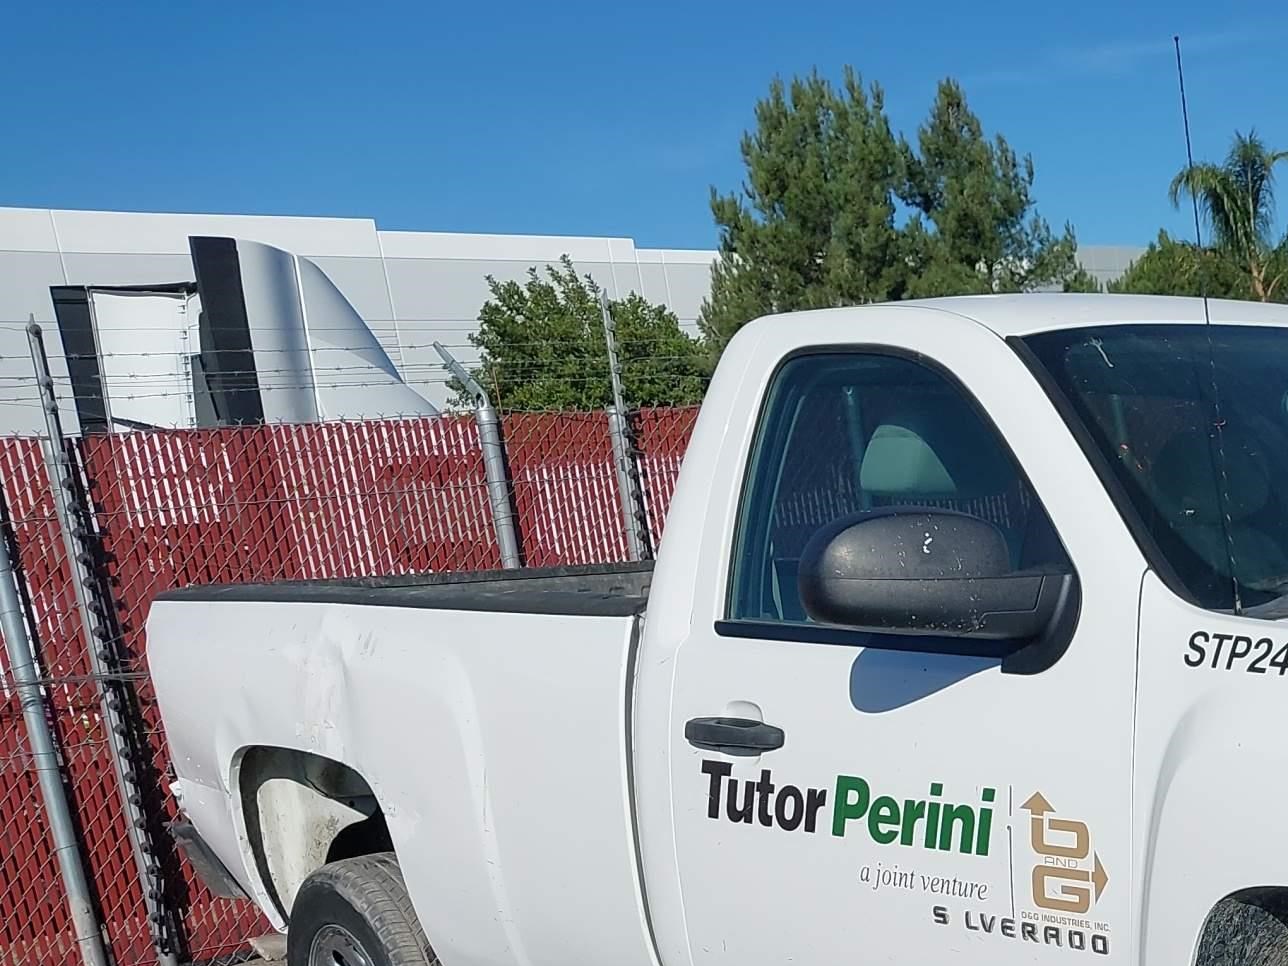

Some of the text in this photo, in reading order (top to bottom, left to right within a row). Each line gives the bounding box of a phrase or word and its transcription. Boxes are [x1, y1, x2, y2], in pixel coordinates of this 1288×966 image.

[1044, 855, 1078, 869] AND
[860, 862, 988, 901] a joint venture
